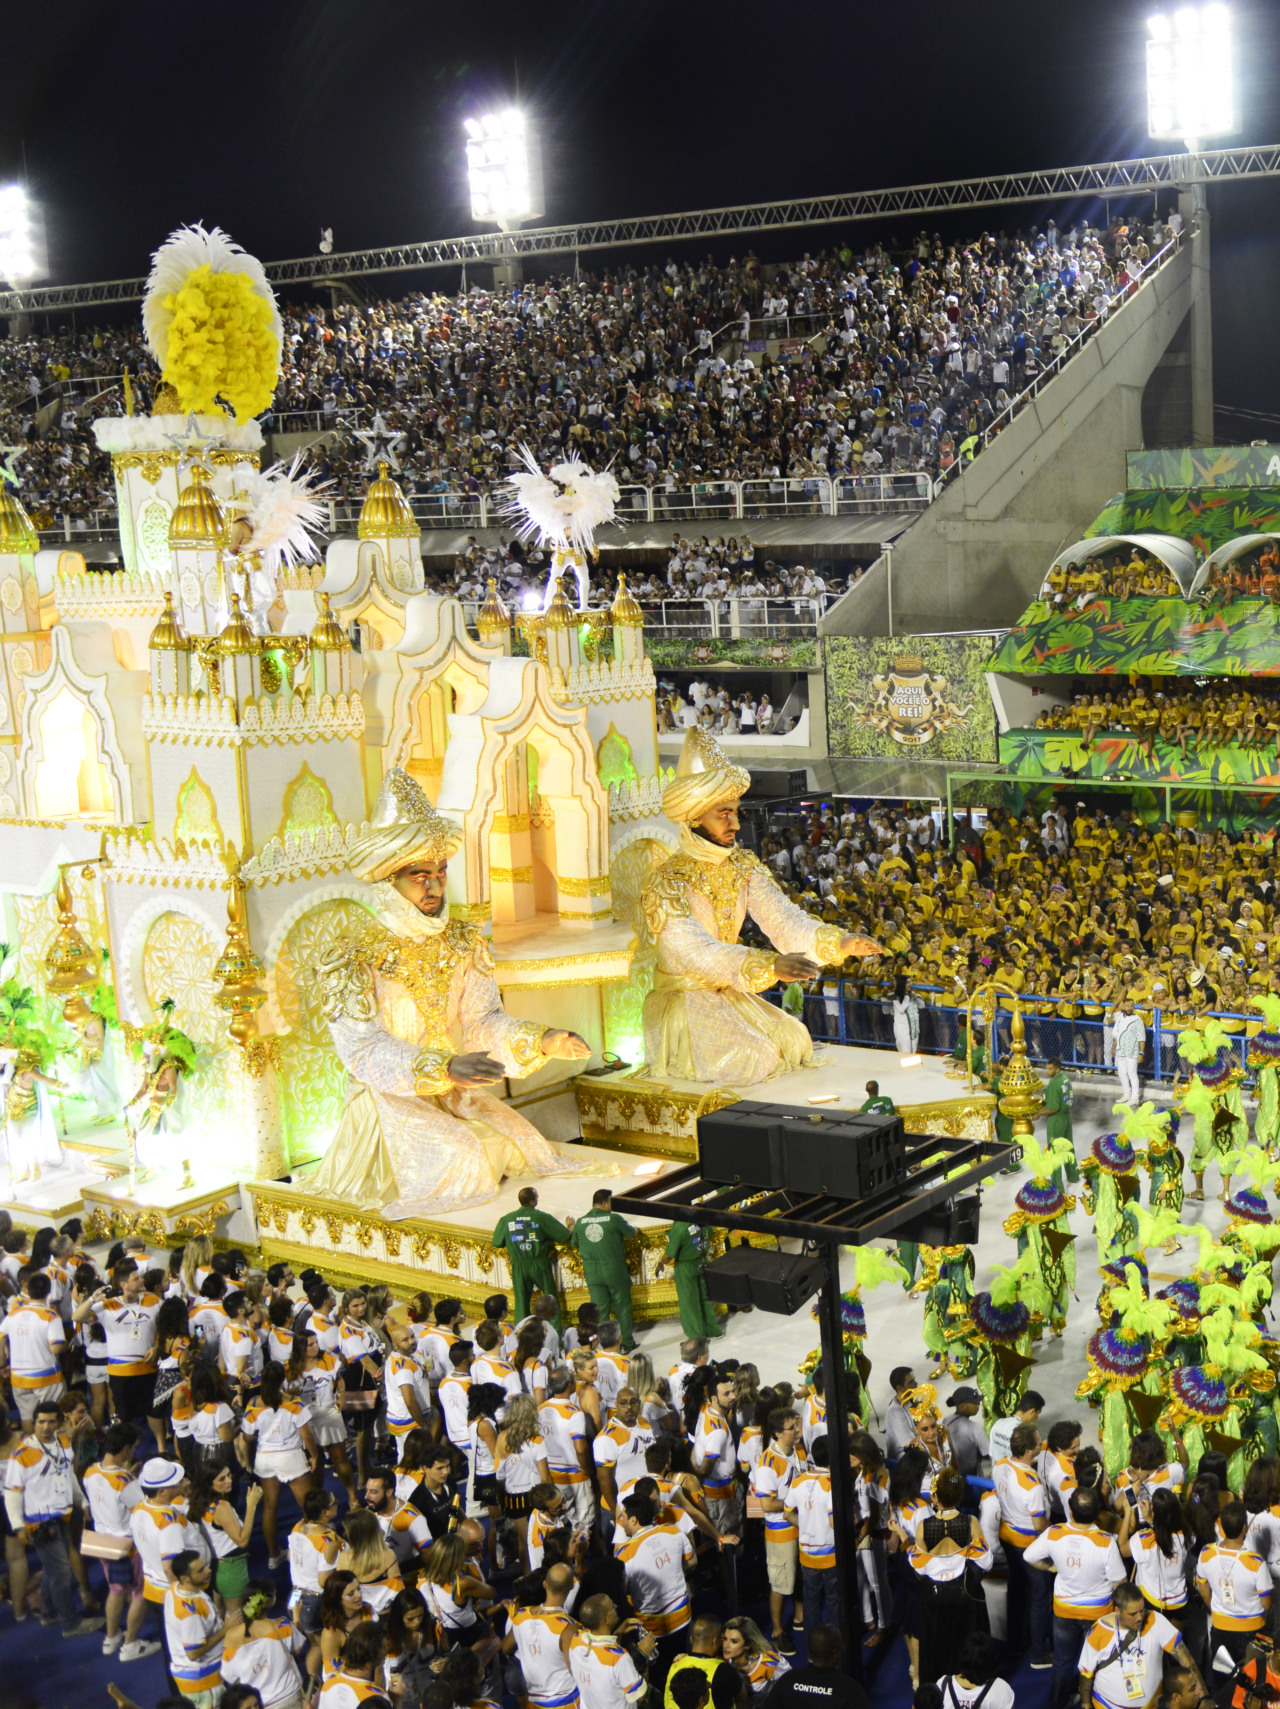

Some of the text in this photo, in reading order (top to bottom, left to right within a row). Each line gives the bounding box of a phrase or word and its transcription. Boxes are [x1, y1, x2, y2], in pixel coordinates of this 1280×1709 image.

[896, 685, 923, 696] AQUI
[922, 697, 930, 706] O
[898, 706, 923, 718] REI!
[902, 735, 922, 744] 2017
[1011, 1148, 1022, 1163] 19
[655, 1553, 671, 1569] 04
[1066, 1556, 1082, 1568] 04
[793, 1683, 833, 1696] CONTROLE
